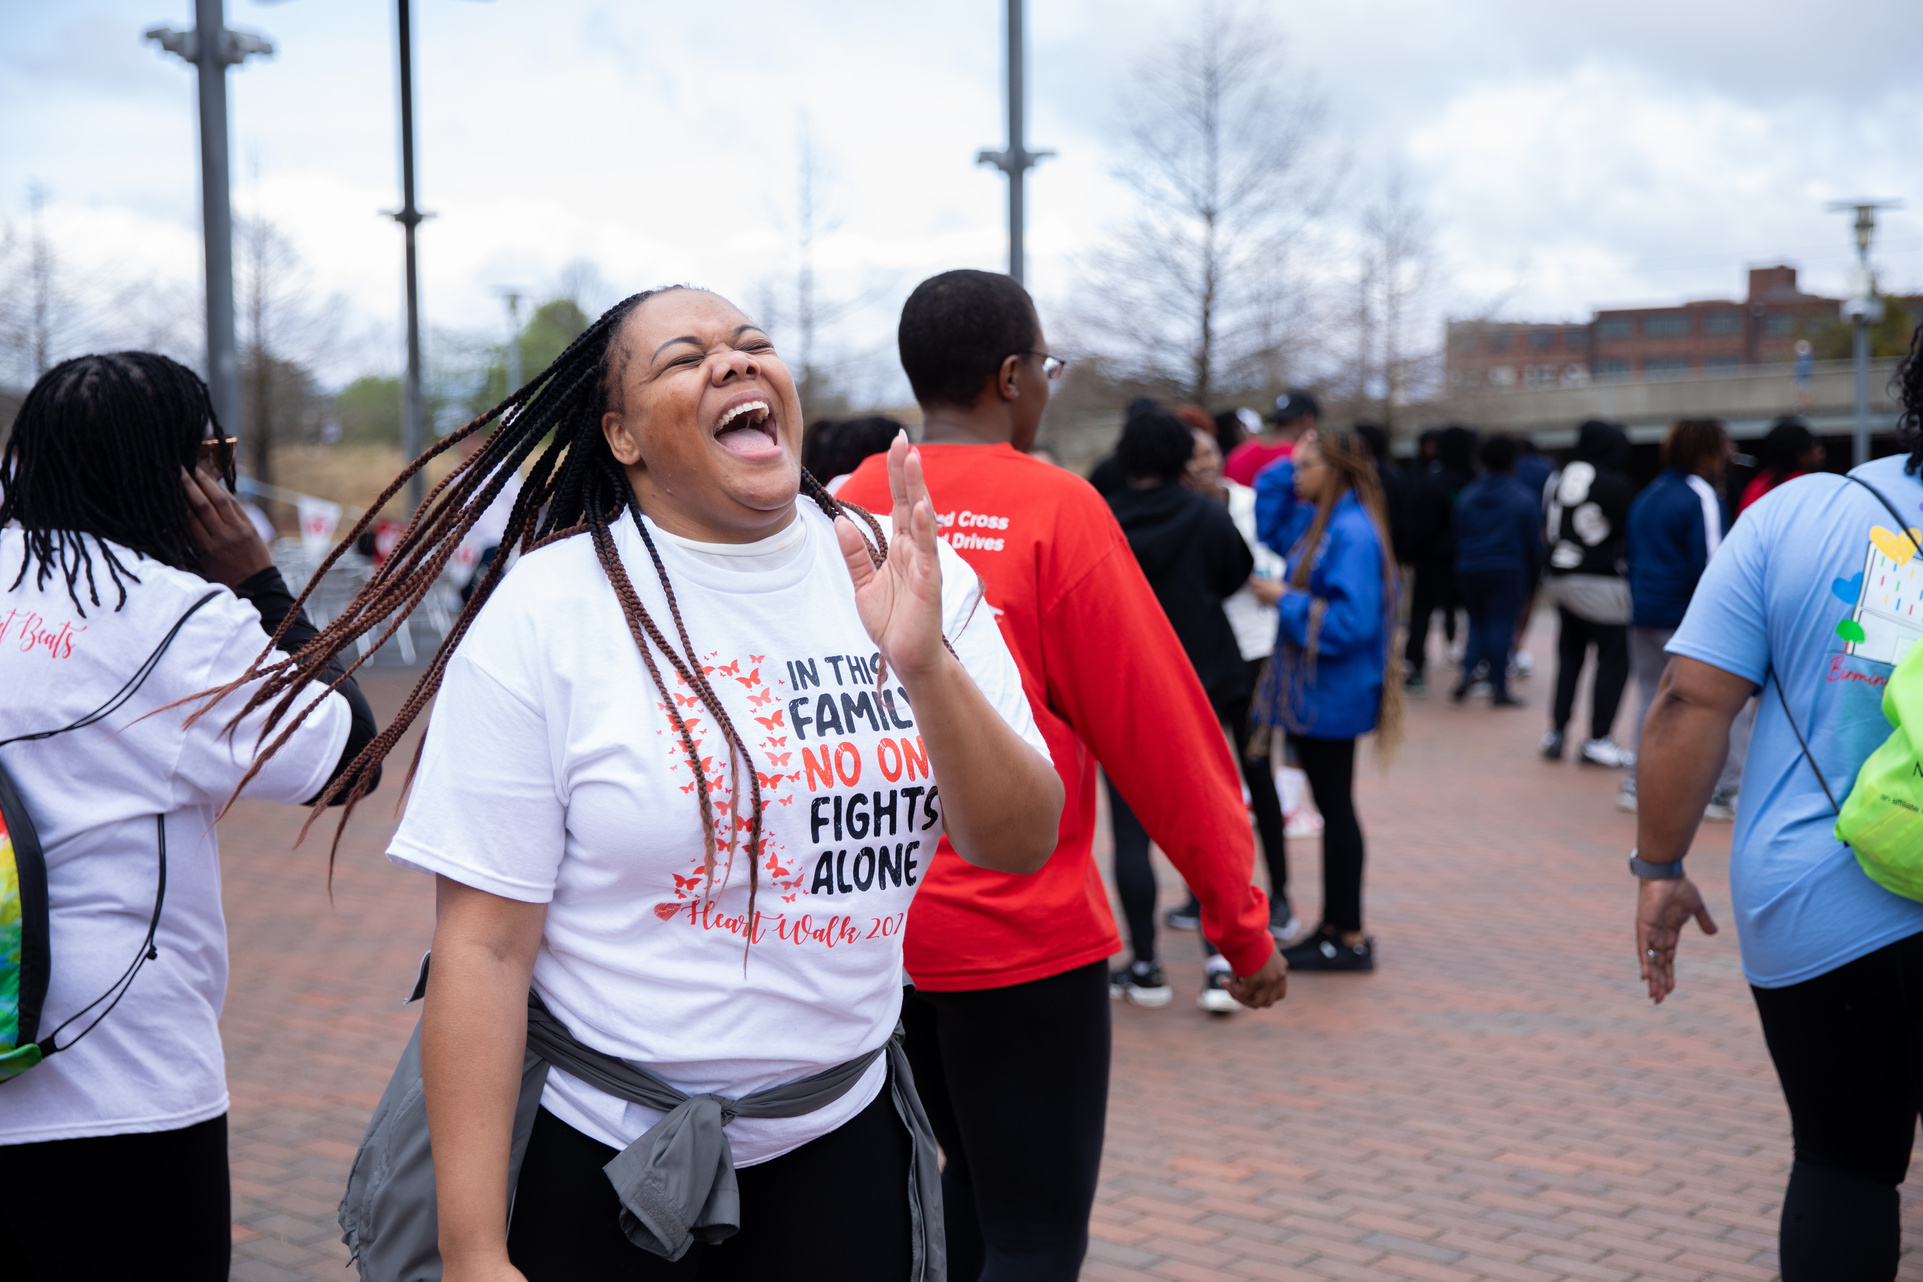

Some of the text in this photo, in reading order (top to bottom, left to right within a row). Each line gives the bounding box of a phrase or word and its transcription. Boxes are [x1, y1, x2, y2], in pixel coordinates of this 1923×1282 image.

[935, 510, 1009, 530] ed Cross
[952, 532, 1005, 551] Drives
[16, 612, 87, 659] Beats
[786, 657, 821, 691] IN
[1825, 654, 1890, 687] Birmin
[801, 735, 930, 792] NO ON
[811, 786, 939, 844] FIGHTS
[811, 841, 920, 895] ALONE
[681, 899, 783, 945] Heart
[771, 914, 861, 948] Walk
